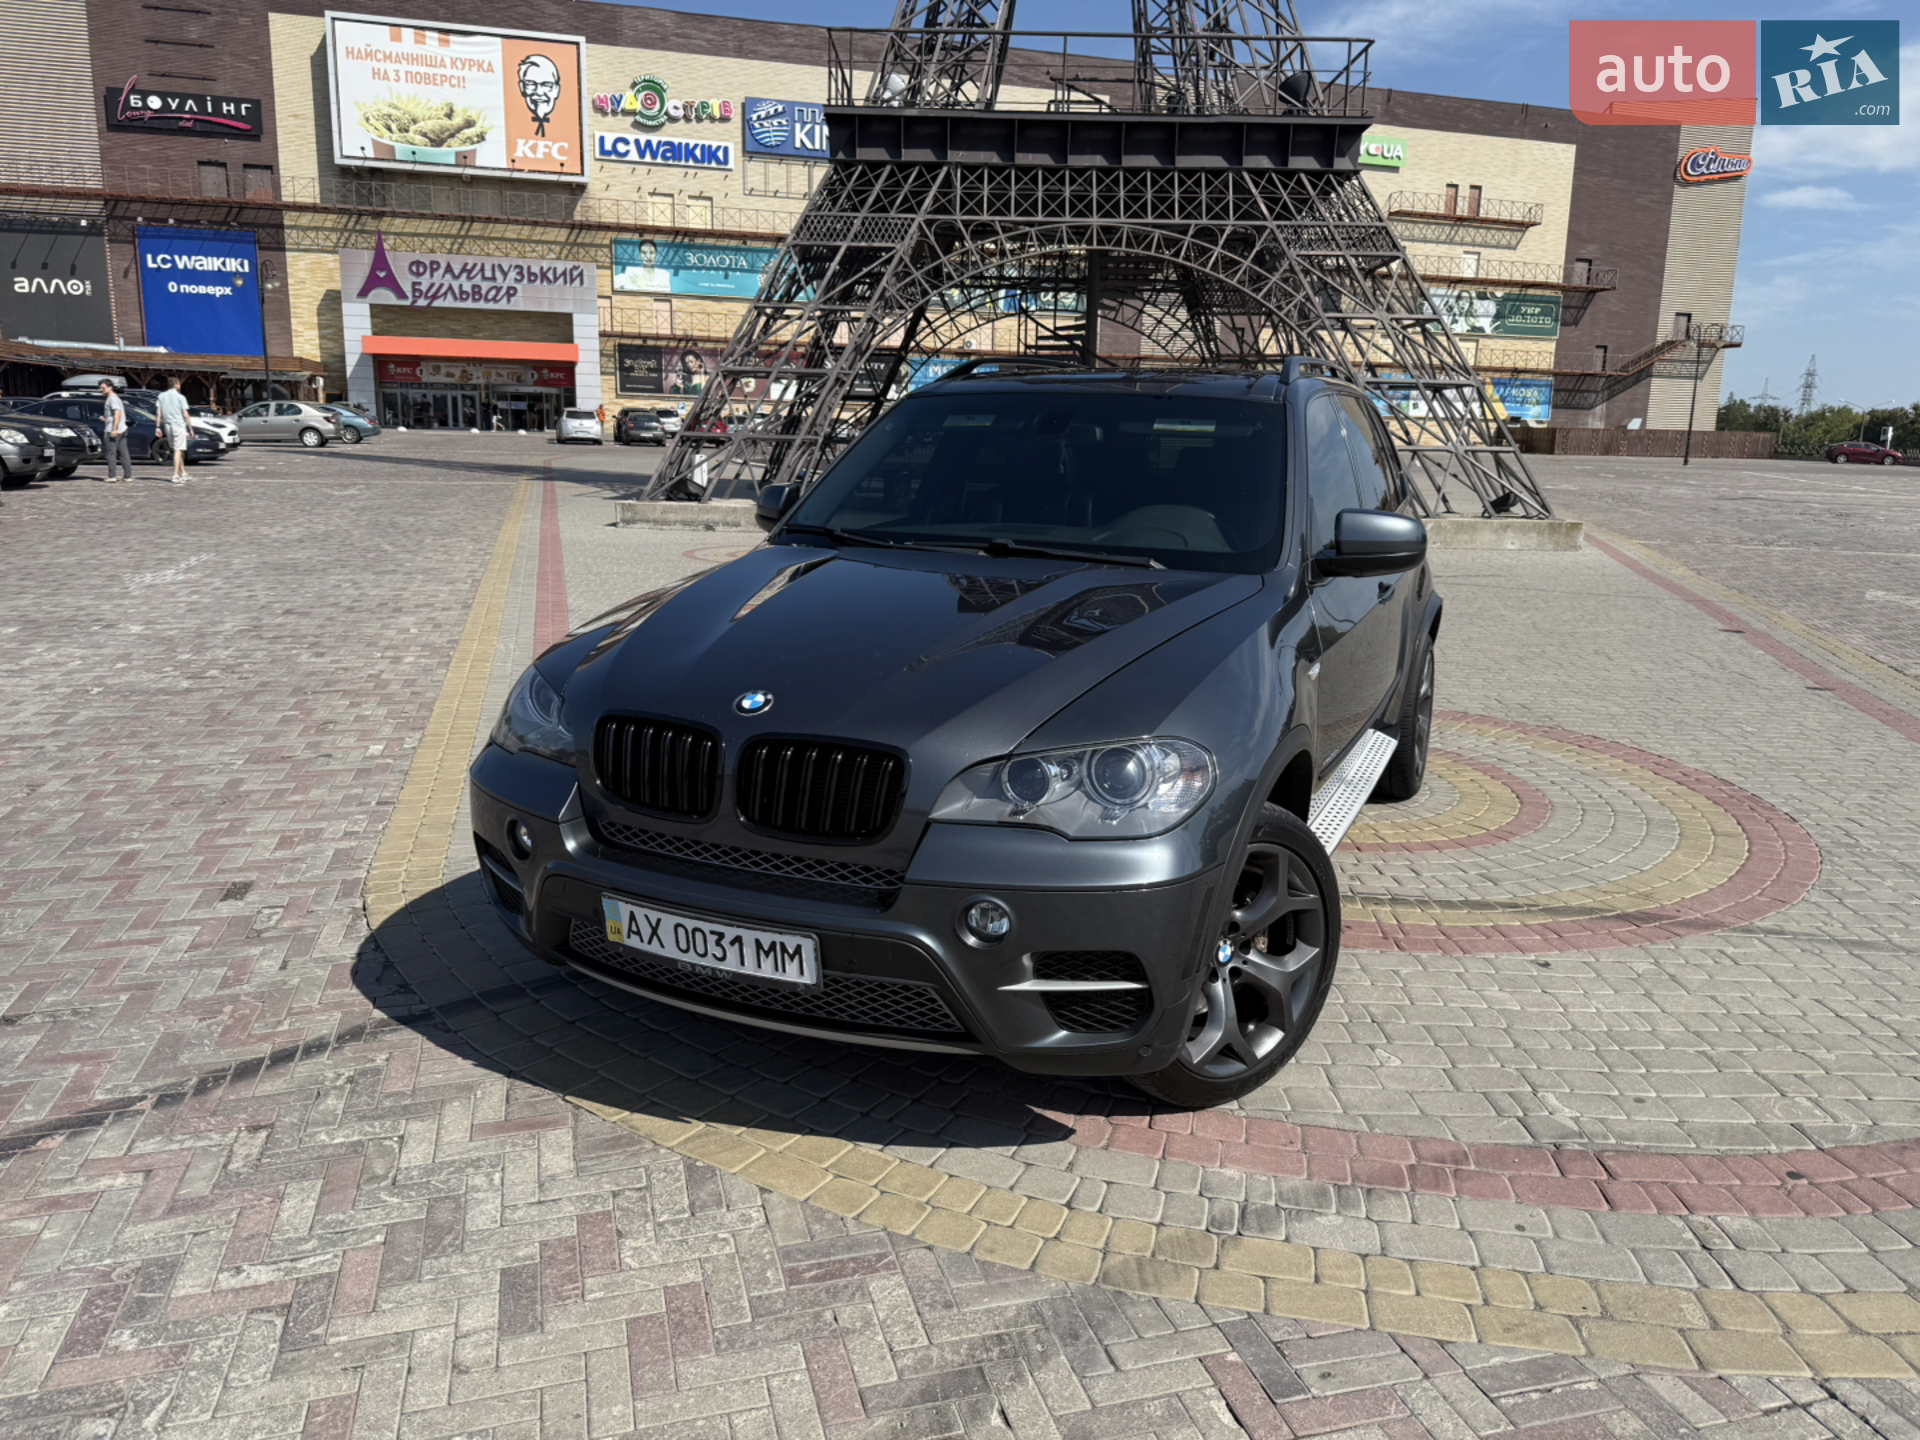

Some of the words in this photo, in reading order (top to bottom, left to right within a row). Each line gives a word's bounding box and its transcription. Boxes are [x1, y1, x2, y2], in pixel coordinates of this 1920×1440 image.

[345, 44, 447, 69] НАЙСМАЧНІША
[450, 57, 495, 73] КУРКА
[371, 67, 391, 82] НА
[393, 69, 402, 83] 3
[404, 70, 467, 89] ПОВЕРСІ!
[514, 138, 569, 161] KFC
[599, 135, 630, 158] LC
[146, 253, 172, 269] LC
[684, 252, 749, 269] ЗОЛОТА
[408, 259, 585, 287] ФРАНЦУЗЬКИЙ
[179, 283, 233, 298] поверх
[610, 924, 622, 936] UA
[626, 910, 666, 949] AX
[673, 922, 746, 967] 0031
[754, 938, 805, 977] MM
[677, 961, 733, 980] BMW
